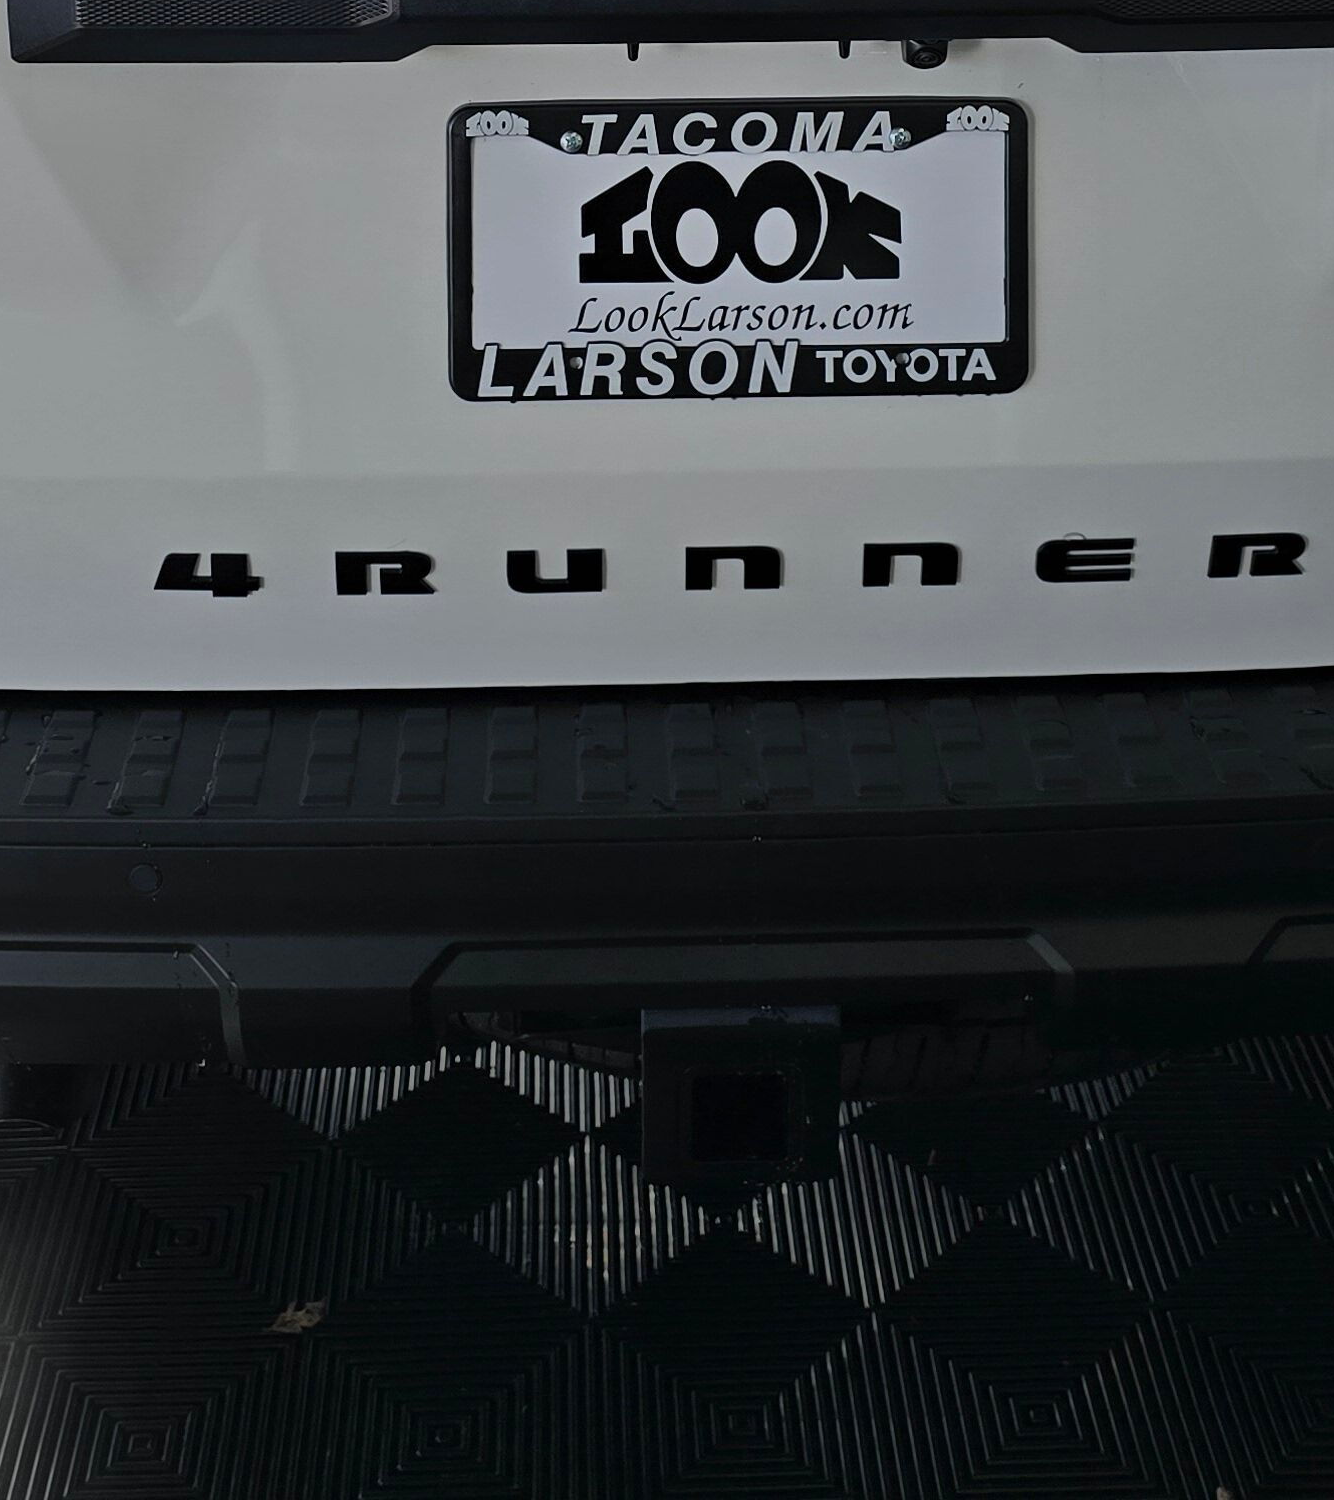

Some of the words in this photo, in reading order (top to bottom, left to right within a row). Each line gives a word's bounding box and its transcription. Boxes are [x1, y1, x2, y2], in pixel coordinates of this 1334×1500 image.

[580, 110, 895, 156] TACOMA
[578, 159, 903, 284] LOOK
[568, 291, 915, 341] LookLarson.com
[477, 339, 800, 397] LARSON
[815, 347, 998, 384] TOYOTA
[153, 532, 1309, 599] 4RUNNER
